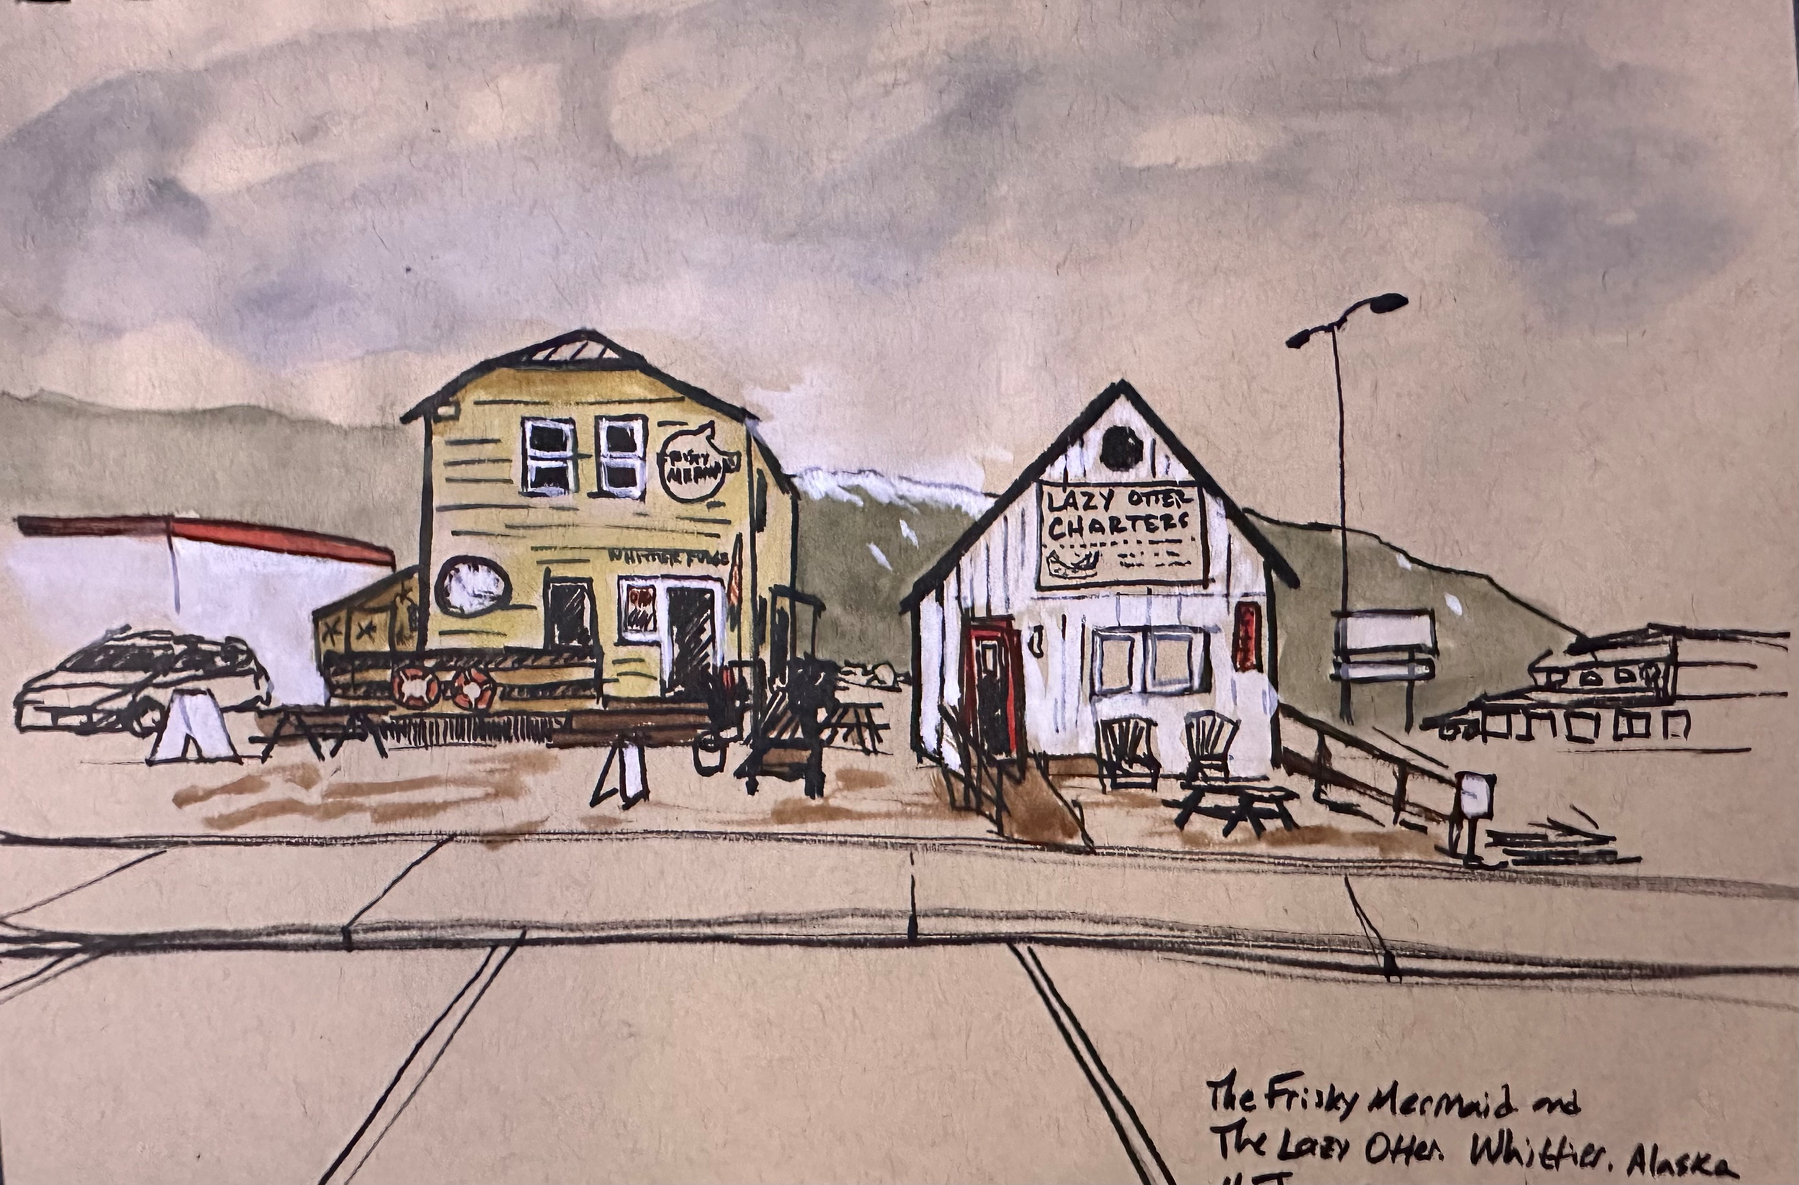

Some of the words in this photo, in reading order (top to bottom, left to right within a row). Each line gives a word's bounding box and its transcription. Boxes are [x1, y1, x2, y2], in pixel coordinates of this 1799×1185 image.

[1047, 488, 1115, 512] LAZY
[1127, 488, 1194, 510] OTTER
[1048, 511, 1190, 541] CHARTERS
[1206, 1066, 1257, 1112] The
[1264, 1070, 1360, 1123] Frisky
[1367, 1079, 1519, 1119] Mermaid
[1532, 1088, 1582, 1116] and
[1209, 1116, 1268, 1160] The
[1276, 1126, 1350, 1163] Lazy
[1626, 1142, 1741, 1180] Alaska
